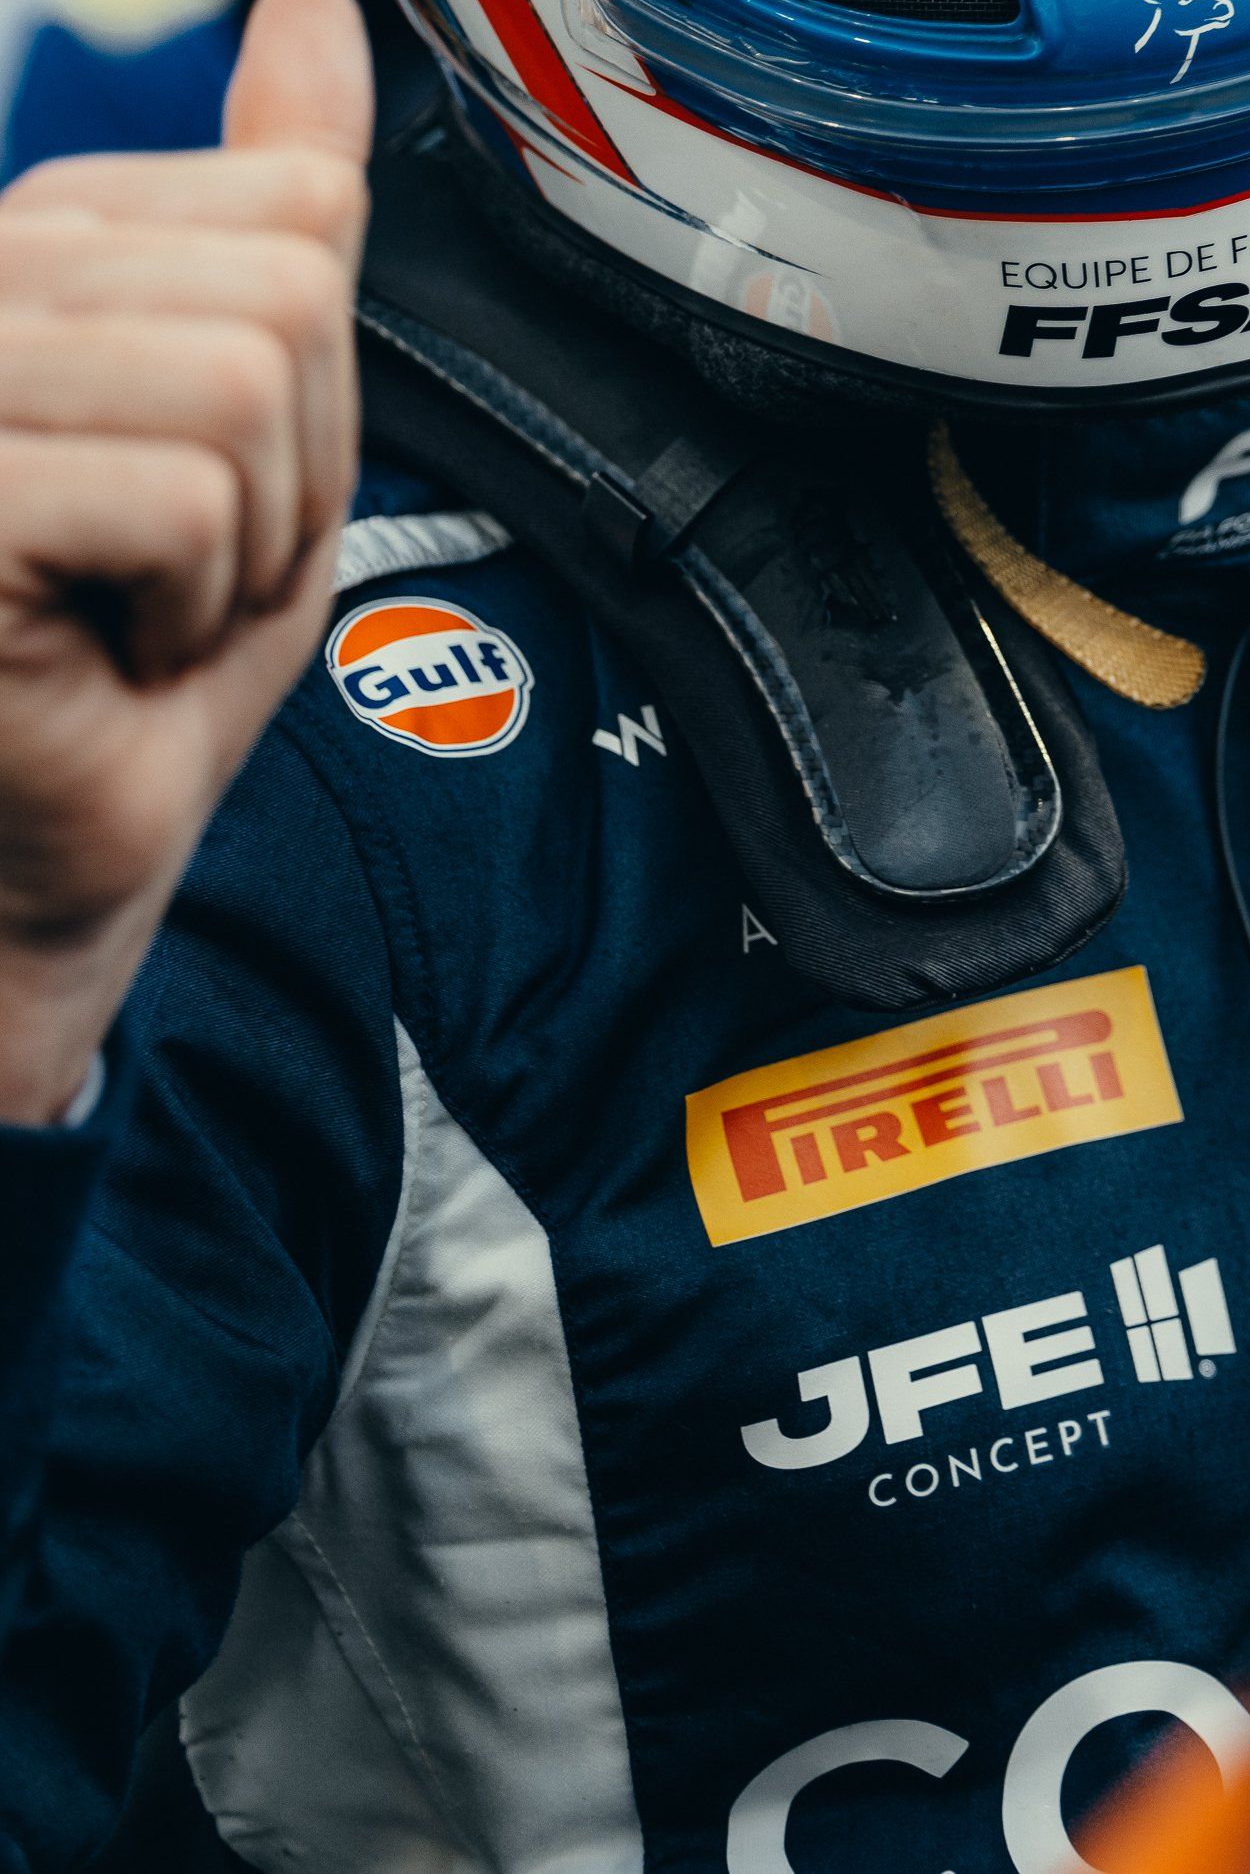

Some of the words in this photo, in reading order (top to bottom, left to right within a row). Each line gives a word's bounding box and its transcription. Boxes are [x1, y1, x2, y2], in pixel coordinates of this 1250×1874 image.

[1001, 255, 1150, 290] EQUIPE
[1166, 243, 1218, 279] DE
[342, 640, 510, 711] Gulf
[721, 1008, 1125, 1204] PIRELLI
[739, 1290, 1105, 1471] JFE
[867, 1409, 1112, 1508] CONCEPT
